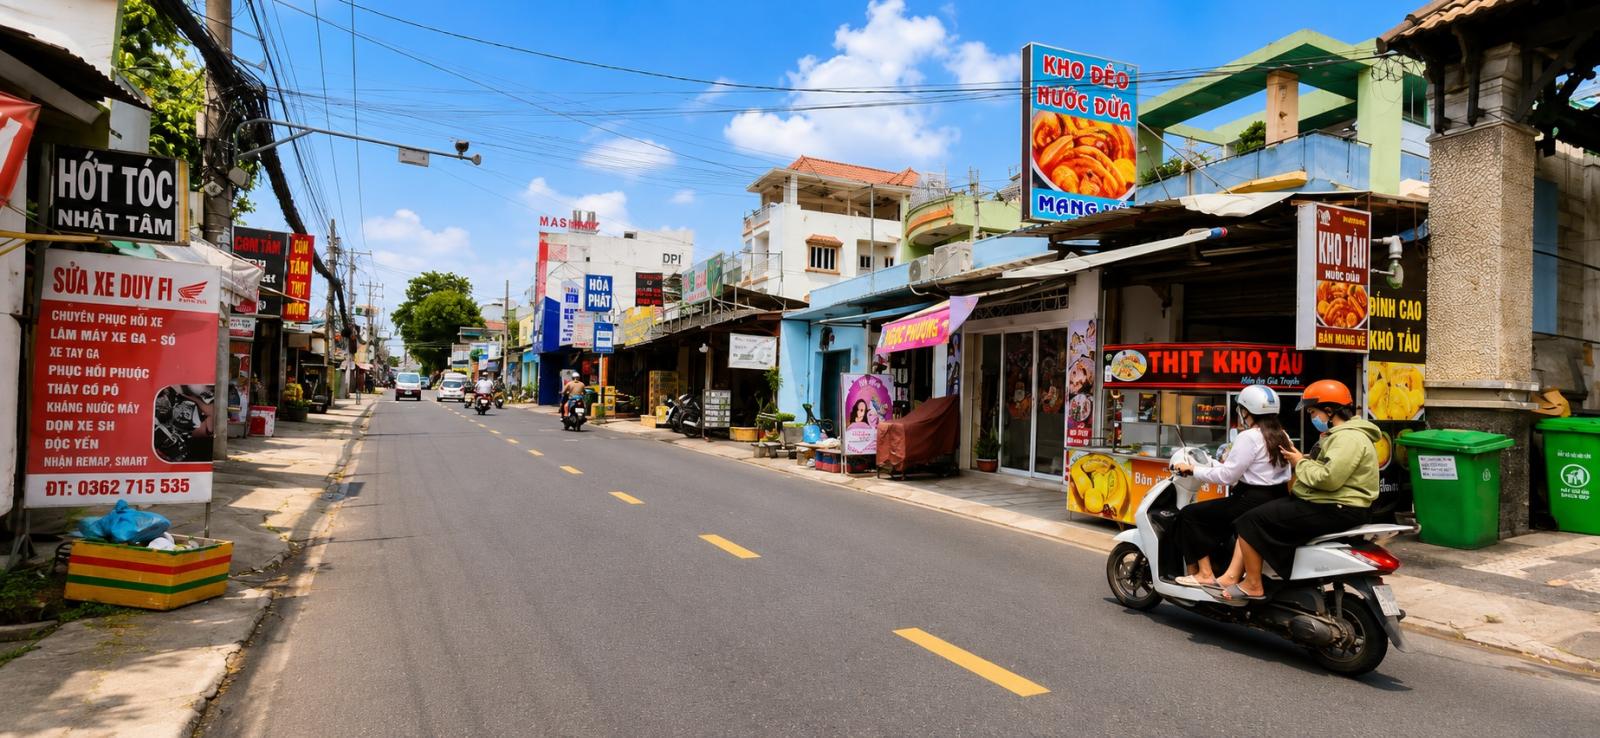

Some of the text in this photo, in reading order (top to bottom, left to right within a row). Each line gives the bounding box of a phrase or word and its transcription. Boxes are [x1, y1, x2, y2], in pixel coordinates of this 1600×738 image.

[1044, 54, 1084, 80] KHO
[58, 151, 172, 209] HỚT TÓC
[58, 208, 172, 235] NHẬT TÂM
[1319, 231, 1341, 266] KHO
[663, 253, 681, 264] DPI
[53, 261, 172, 301] SỬA XE DUY FI
[1400, 299, 1421, 320] CAO
[150, 317, 163, 327] XE
[112, 332, 127, 342] XE
[131, 333, 146, 344] GA
[1335, 333, 1355, 346] MANG
[50, 347, 99, 359] XE TAY GA
[1149, 351, 1203, 378] THỊT
[1213, 351, 1262, 374] KHO
[77, 421, 93, 431] XE
[98, 421, 115, 431] SH
[76, 457, 112, 467] REMAP,
[115, 456, 148, 466] SMART
[46, 478, 189, 496] ĐT: 0362 715 535
